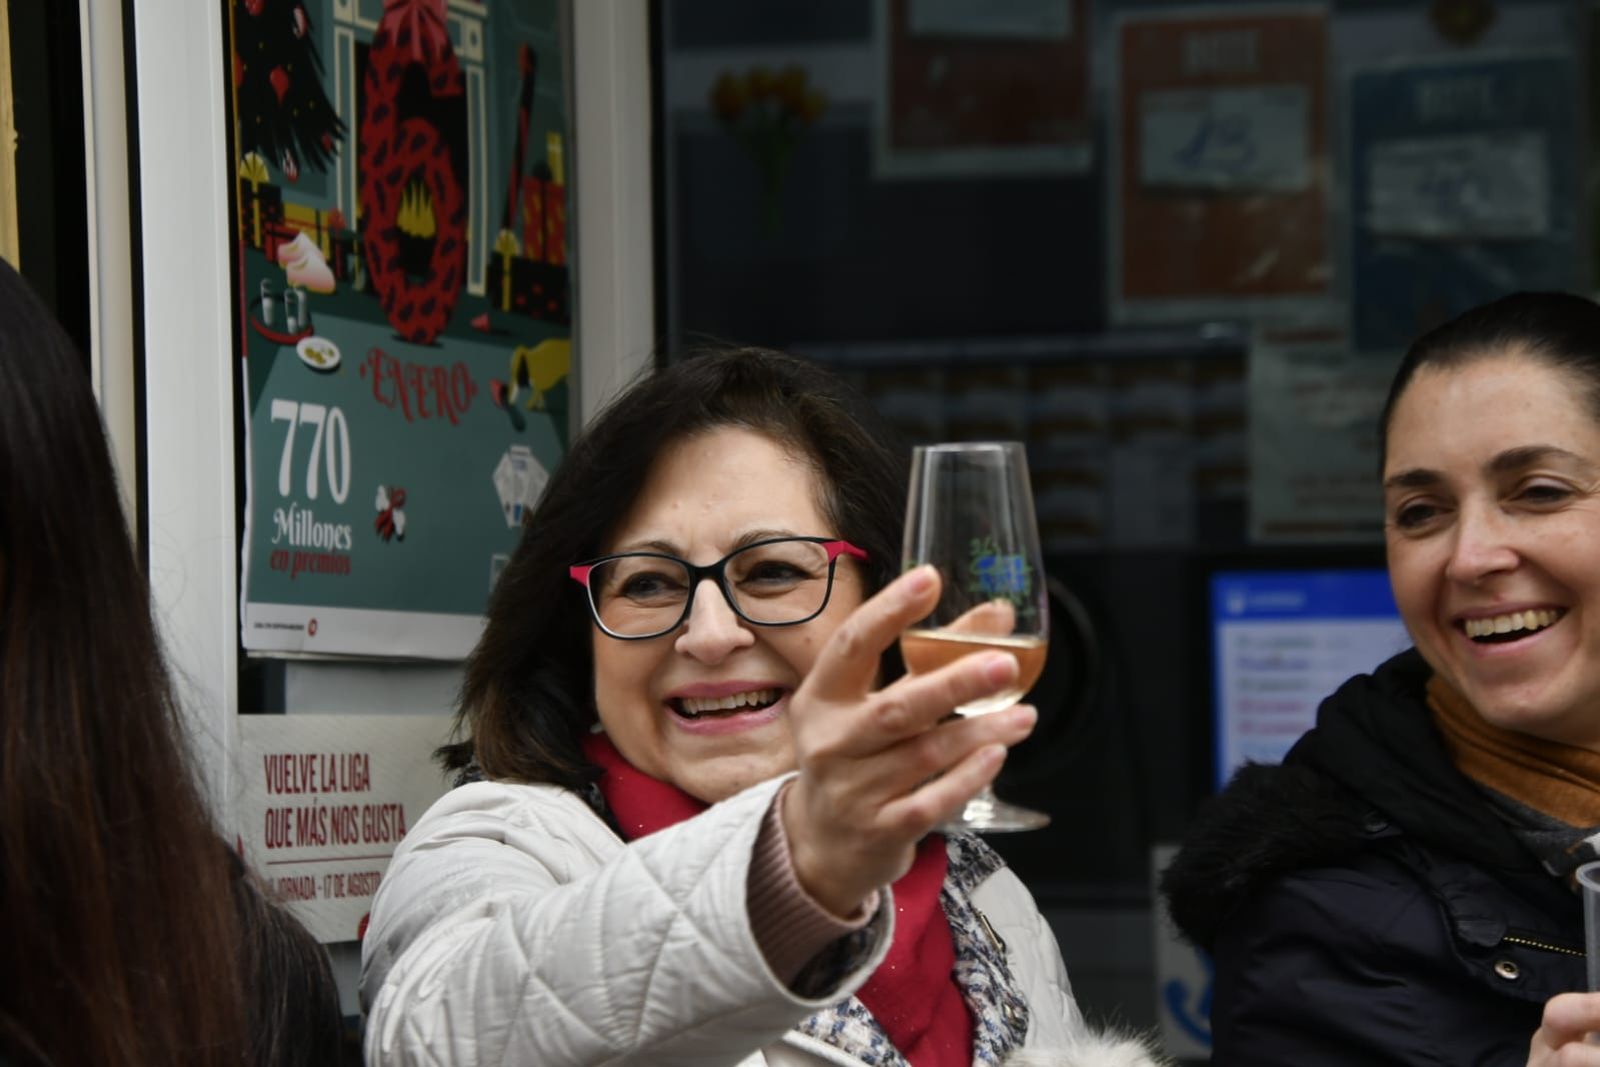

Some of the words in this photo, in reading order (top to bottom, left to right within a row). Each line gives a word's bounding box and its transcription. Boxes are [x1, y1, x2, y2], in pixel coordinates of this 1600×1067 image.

[366, 347, 472, 425] ENERO
[270, 398, 351, 504] 770
[272, 501, 352, 552] Millones
[271, 549, 289, 572] en
[290, 551, 352, 580] premios
[264, 754, 317, 794] VUELVE
[320, 754, 337, 793] LA
[340, 753, 371, 792] LIGA
[264, 808, 293, 849] QUE
[296, 797, 327, 847] MÁS
[331, 805, 358, 844] NOS
[362, 803, 407, 843] GUSTA
[334, 873, 346, 897] DE
